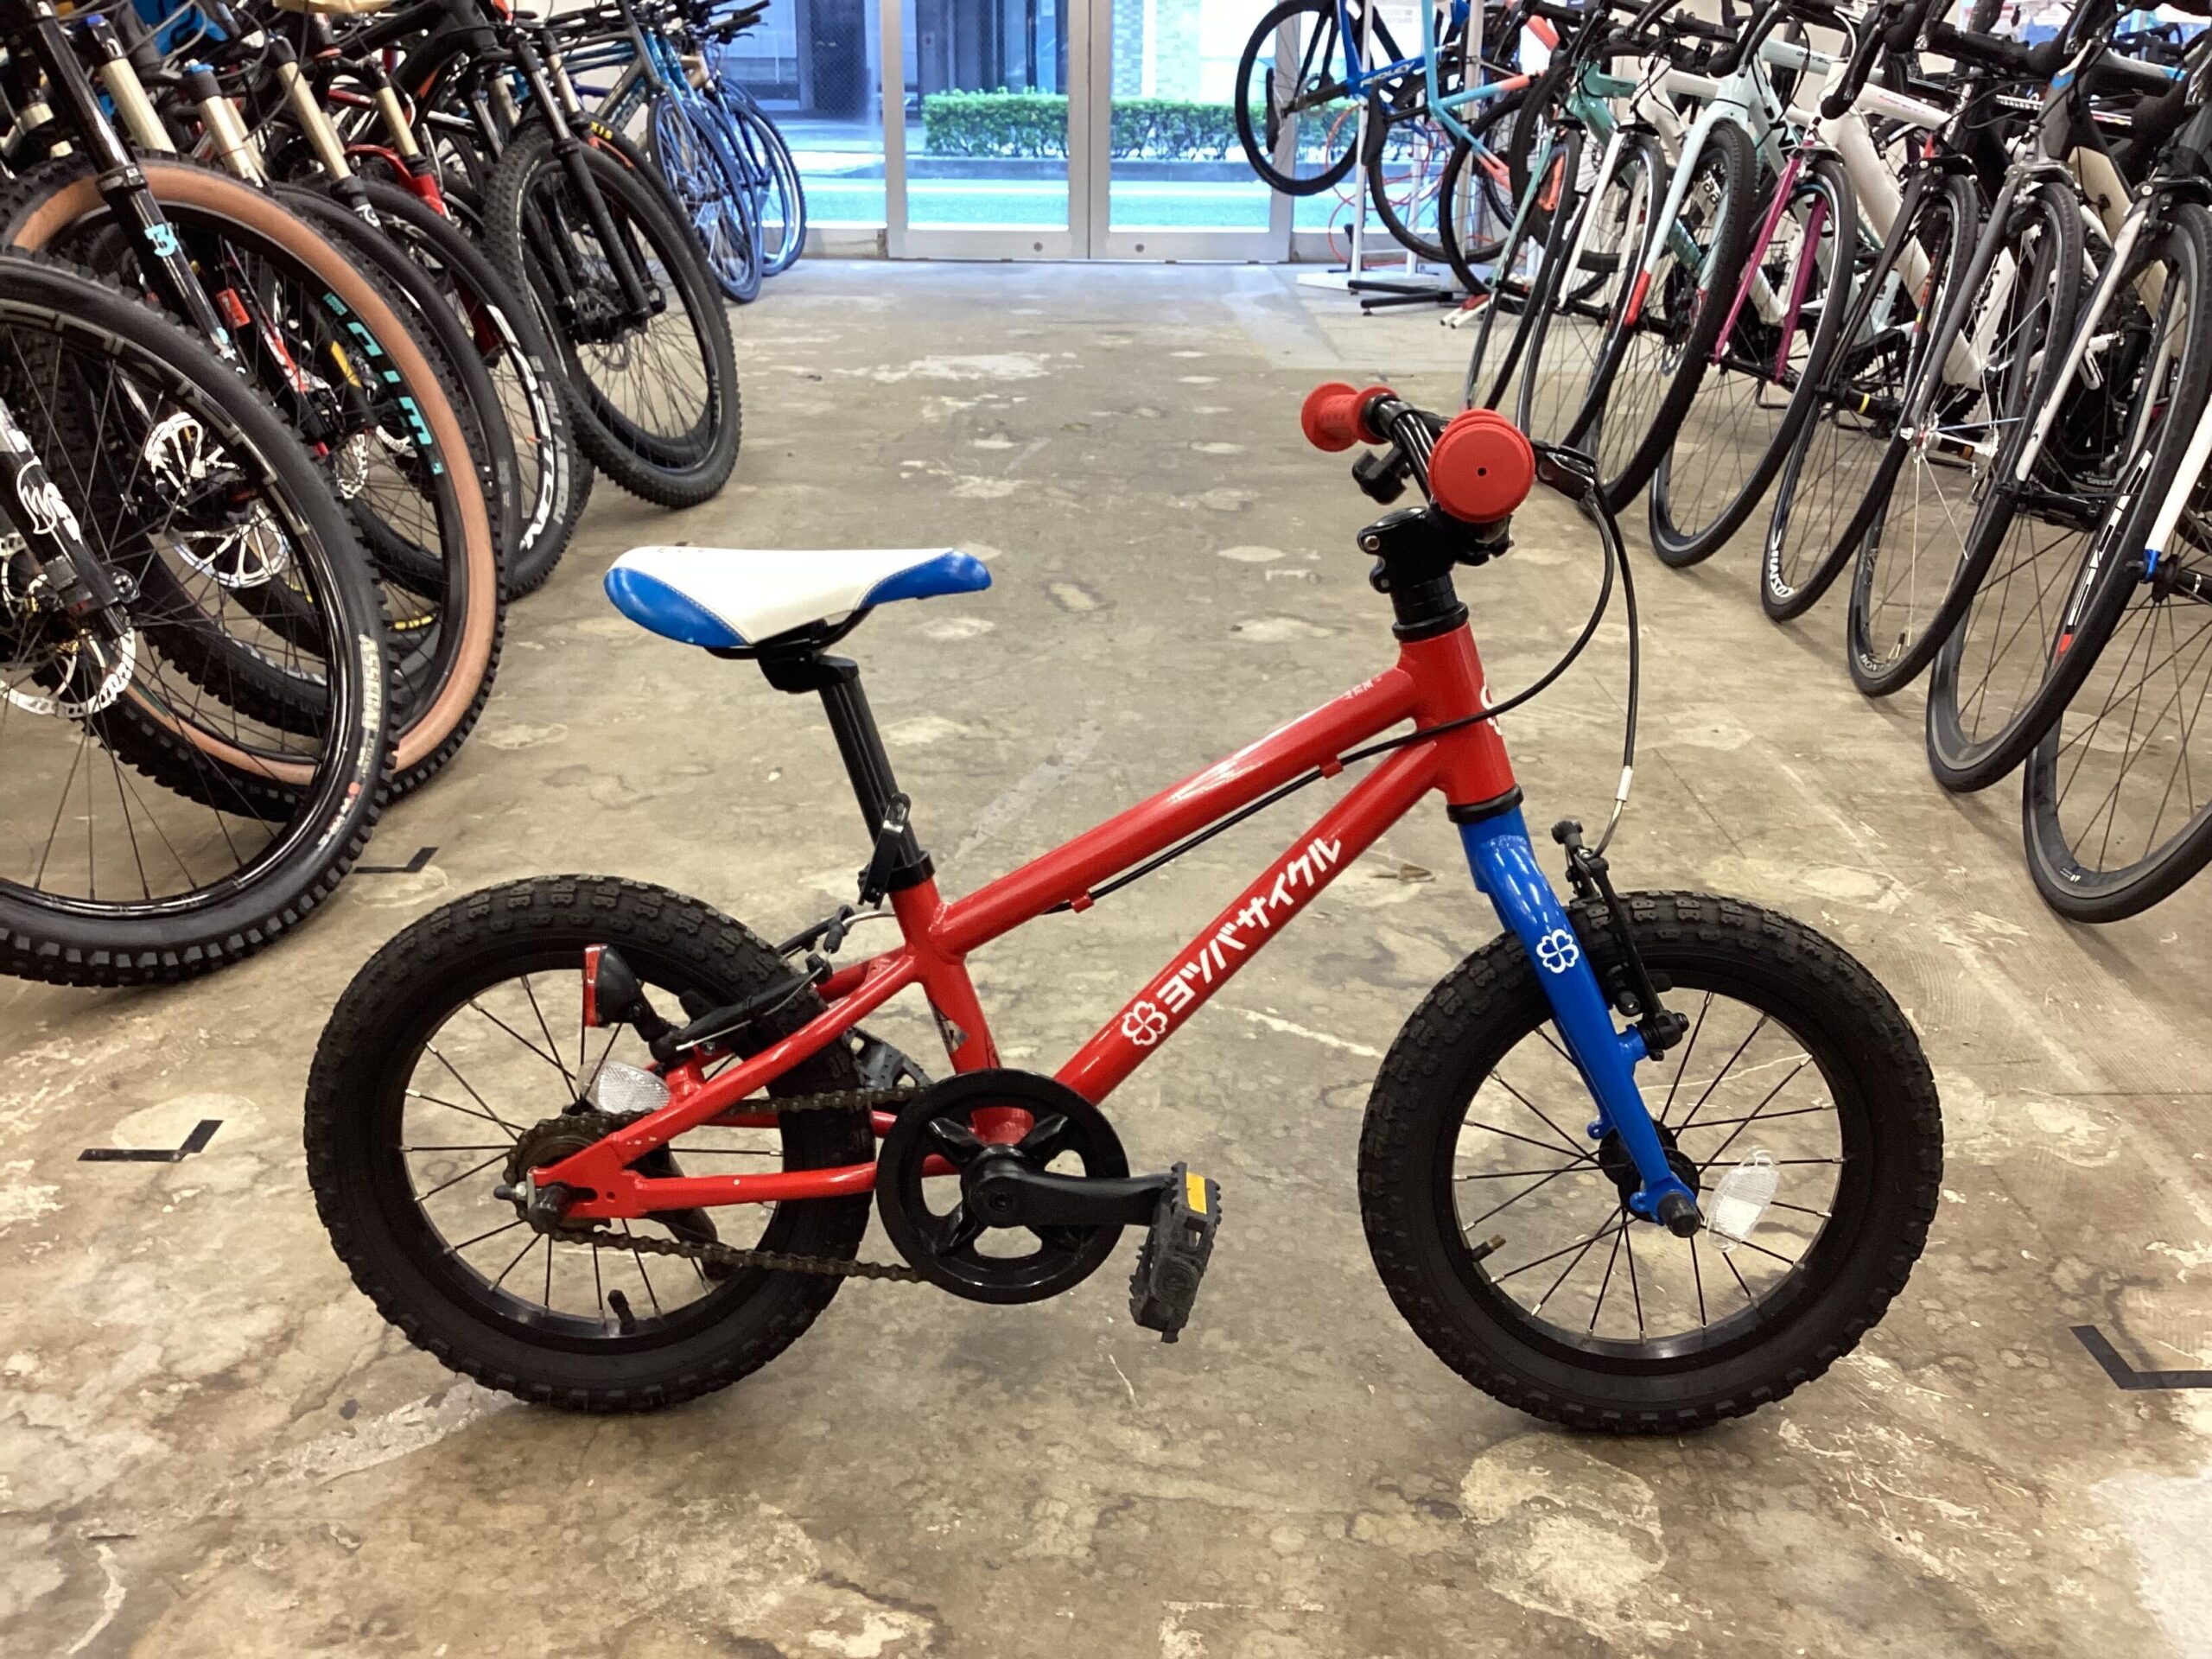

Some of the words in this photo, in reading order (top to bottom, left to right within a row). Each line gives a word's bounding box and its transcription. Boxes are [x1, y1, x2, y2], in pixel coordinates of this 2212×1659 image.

[359, 633, 382, 733] ASSEGAI
[1155, 836, 1342, 1014] ヨツバサイクル
